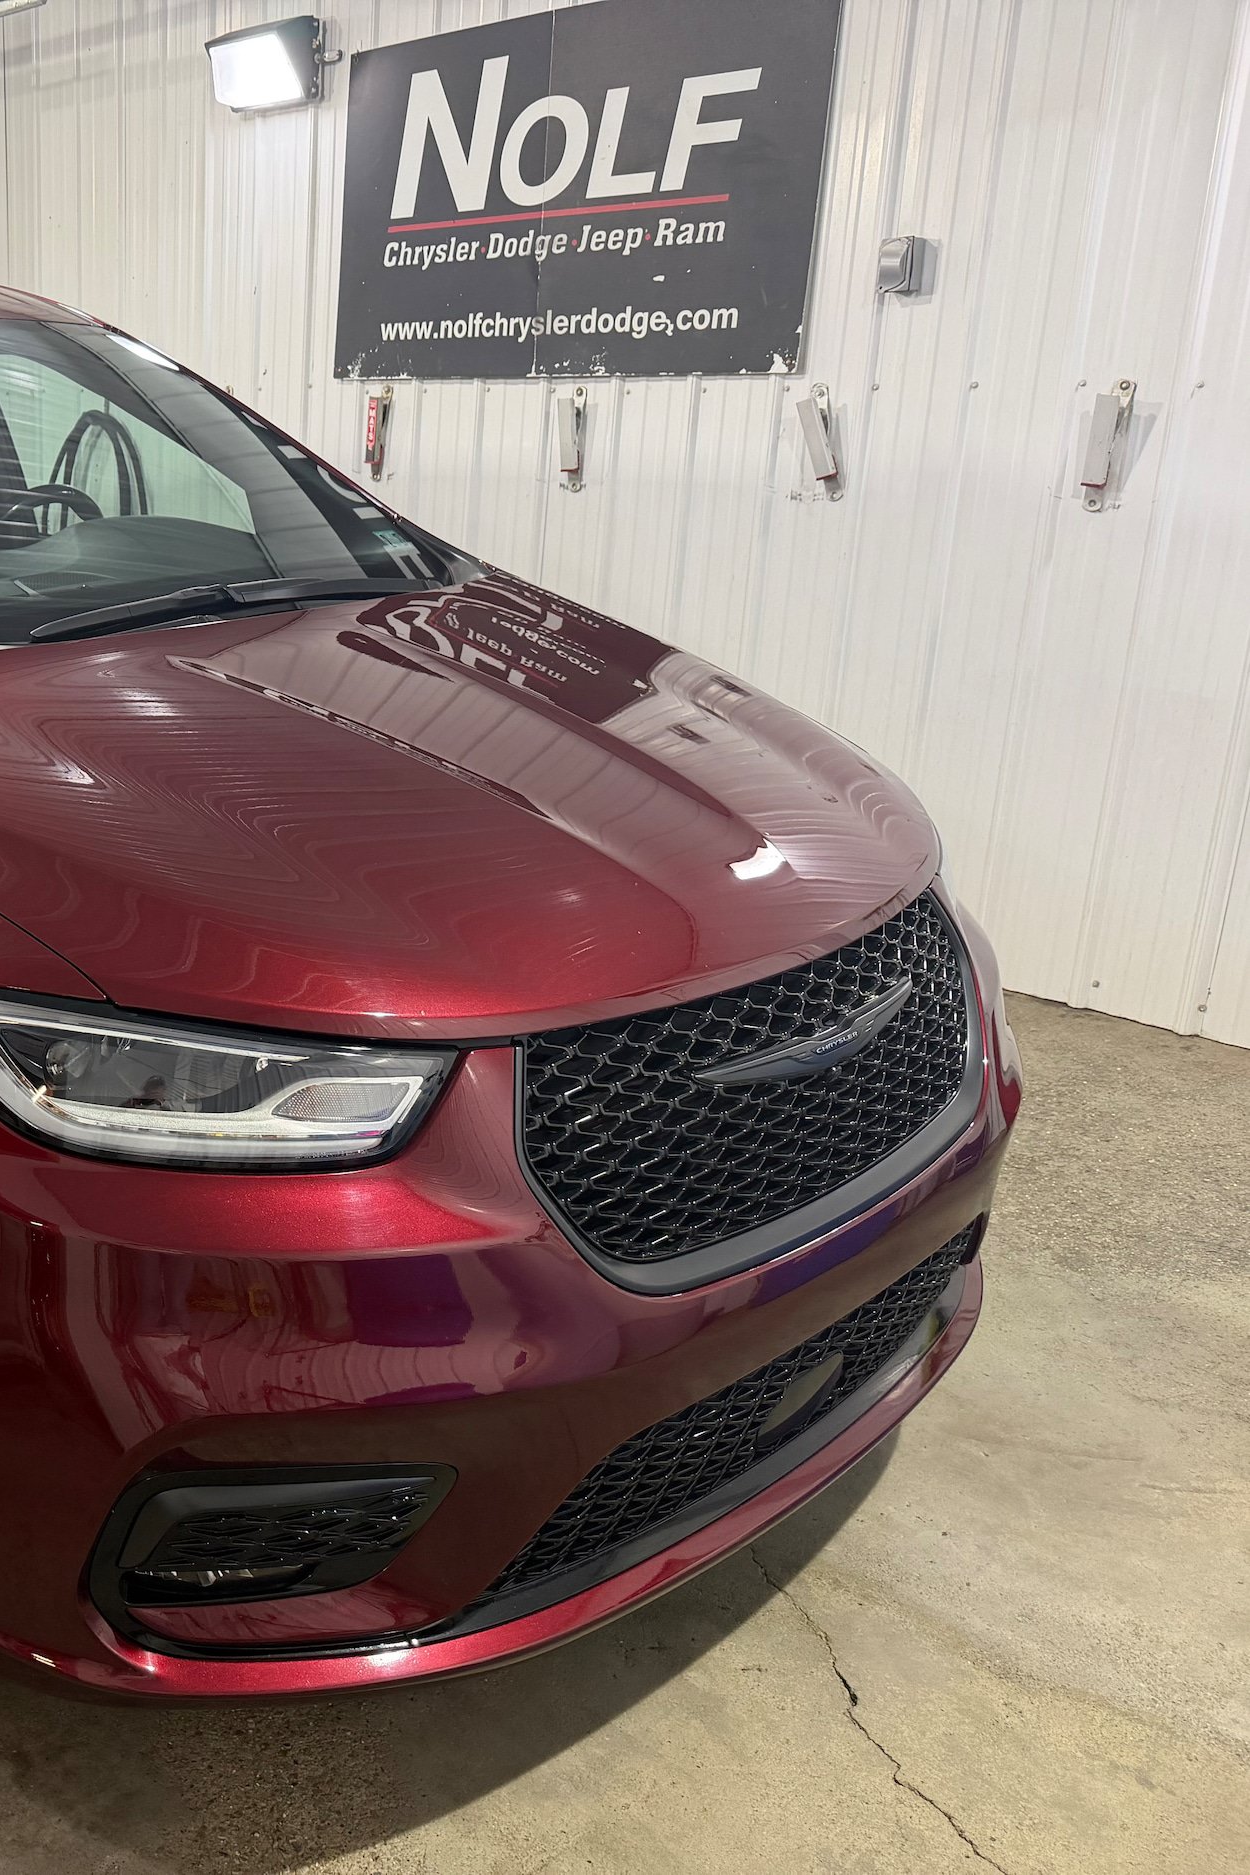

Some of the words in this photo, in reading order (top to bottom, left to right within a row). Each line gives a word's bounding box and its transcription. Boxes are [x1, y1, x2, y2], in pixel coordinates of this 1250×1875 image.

[383, 238, 480, 270] Chrysler
[487, 229, 568, 262] Dodge
[577, 224, 643, 255] Jeep
[654, 217, 726, 247] Ram
[816, 1031, 858, 1054] CHRYSLER
